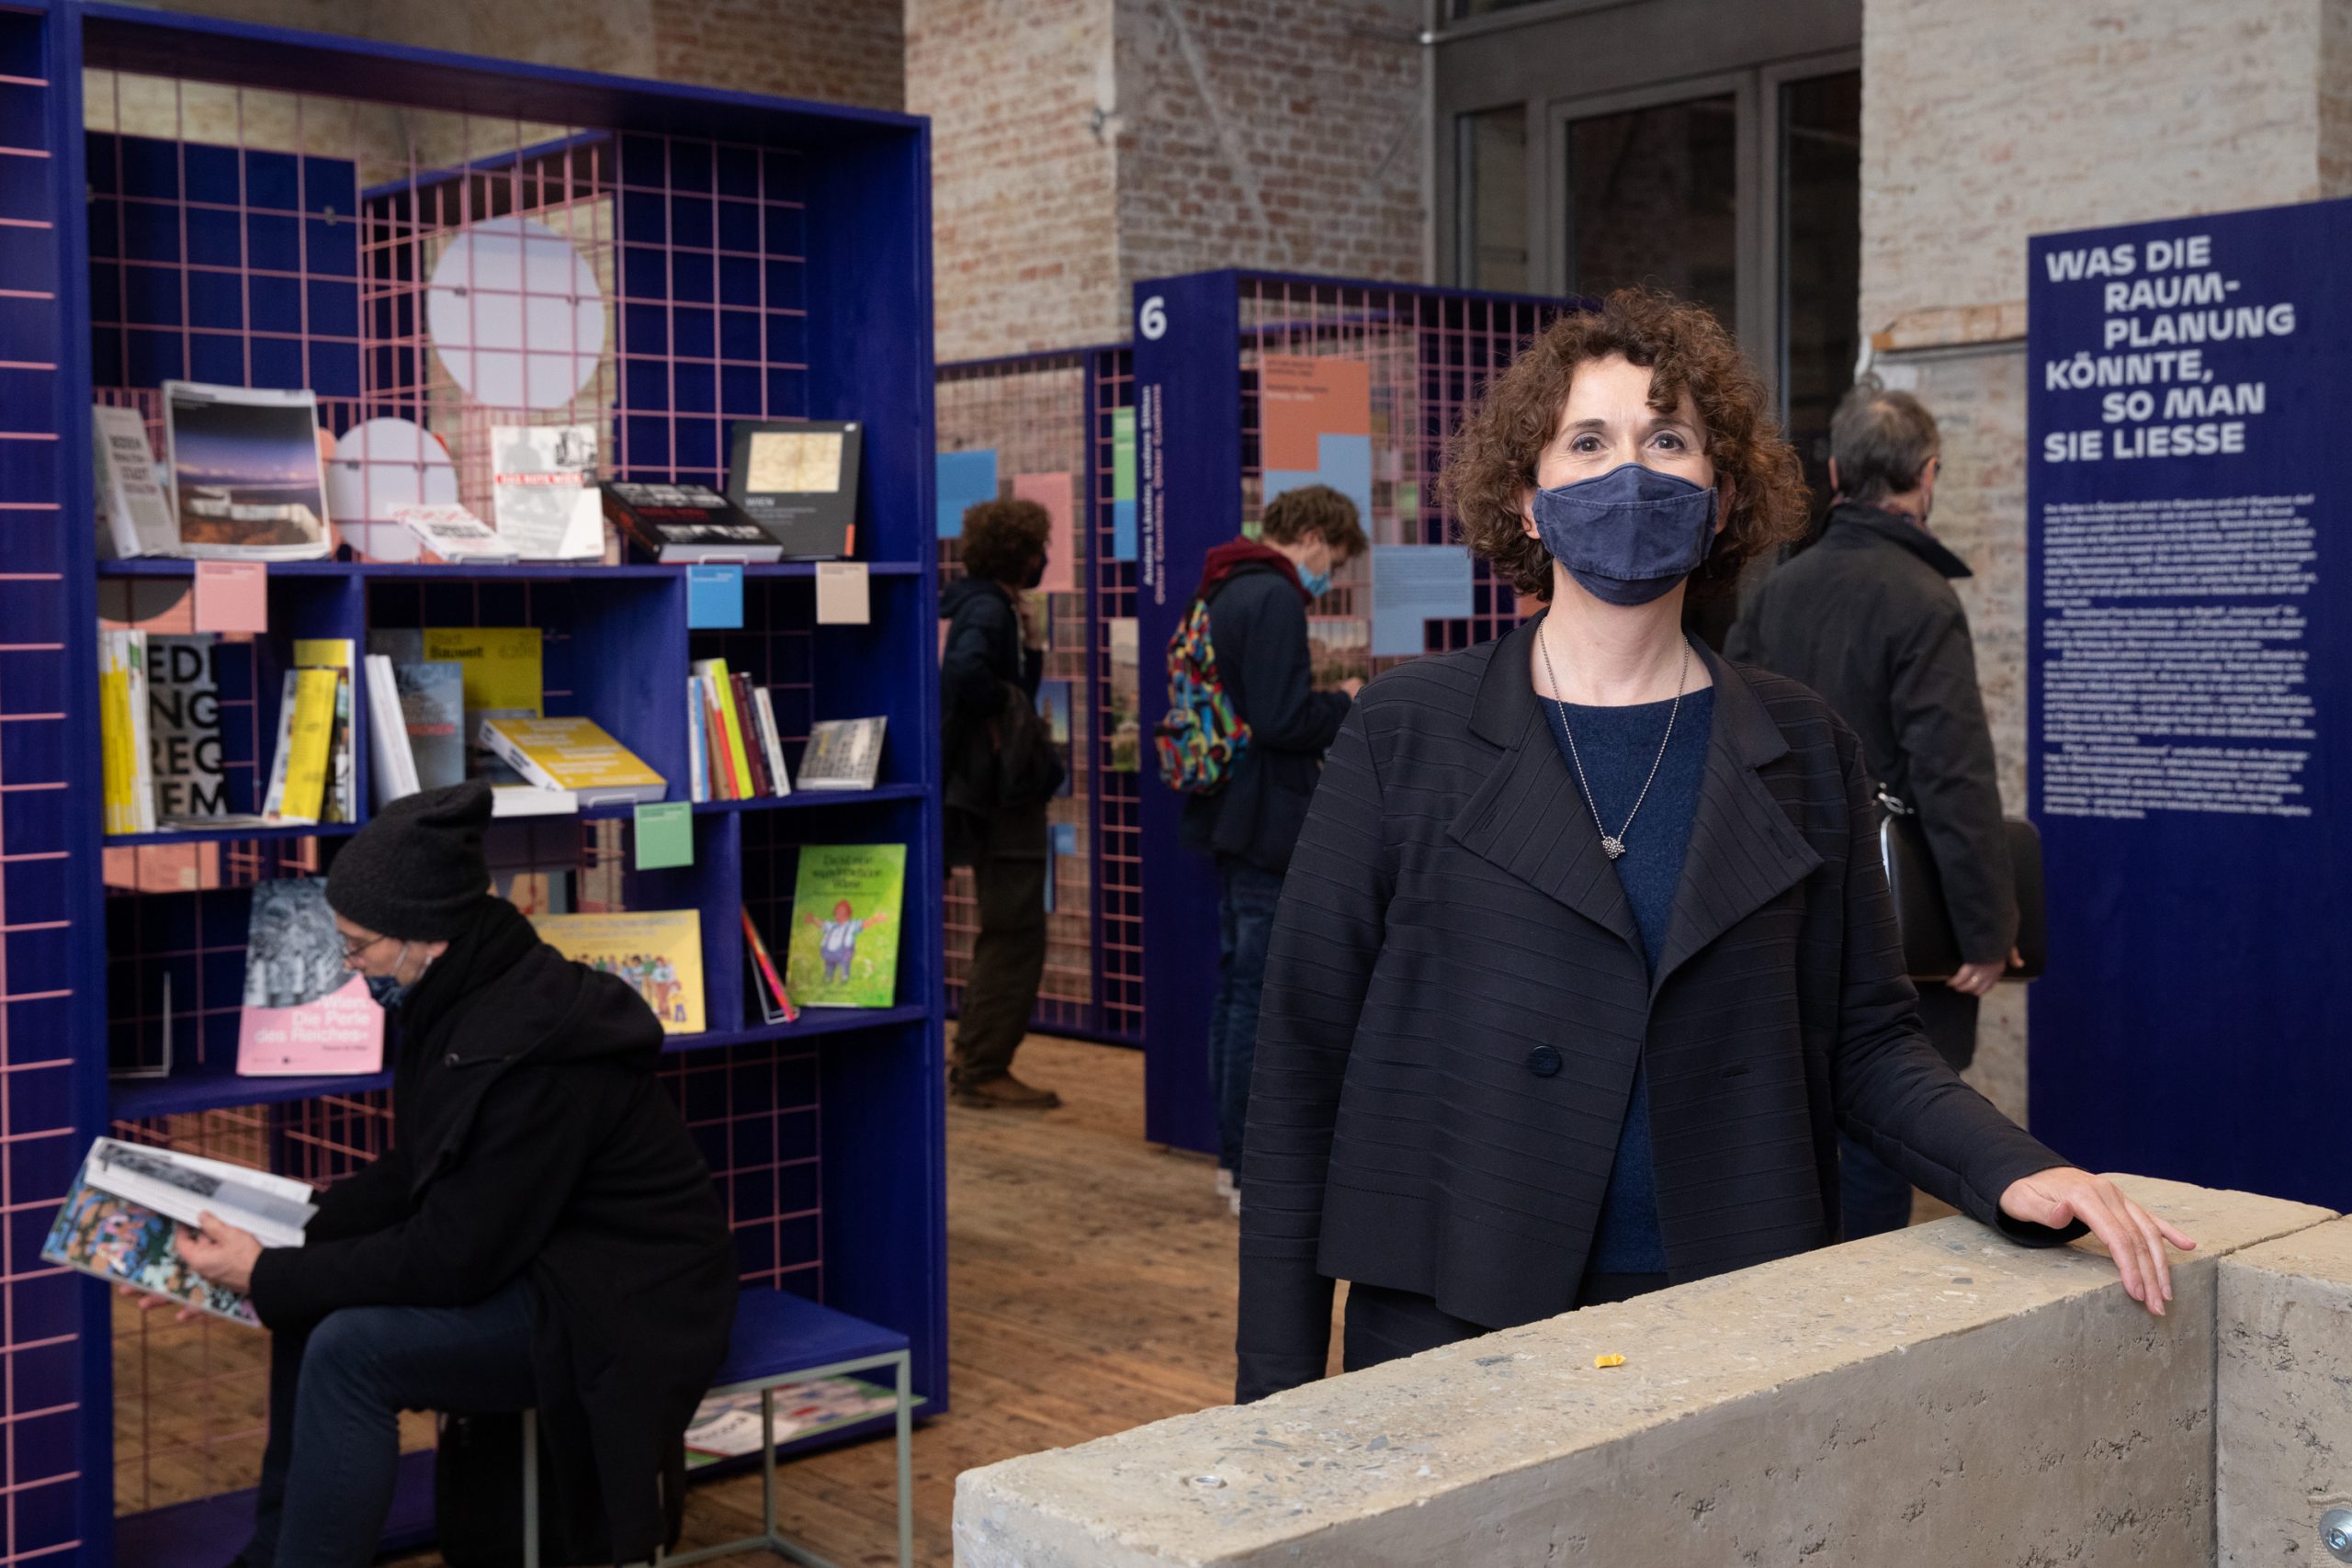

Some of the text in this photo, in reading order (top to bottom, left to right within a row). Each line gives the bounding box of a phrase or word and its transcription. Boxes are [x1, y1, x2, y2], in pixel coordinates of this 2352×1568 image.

[2046, 236, 2211, 282] WAS DIE
[2105, 272, 2241, 312] RAUM-
[1140, 296, 1167, 340] 6
[2105, 303, 2295, 349] PLANUNG
[2046, 350, 2213, 390] KÖNNTE,
[2102, 383, 2266, 423] SO MAN
[2044, 423, 2245, 462] SIE LIESSE
